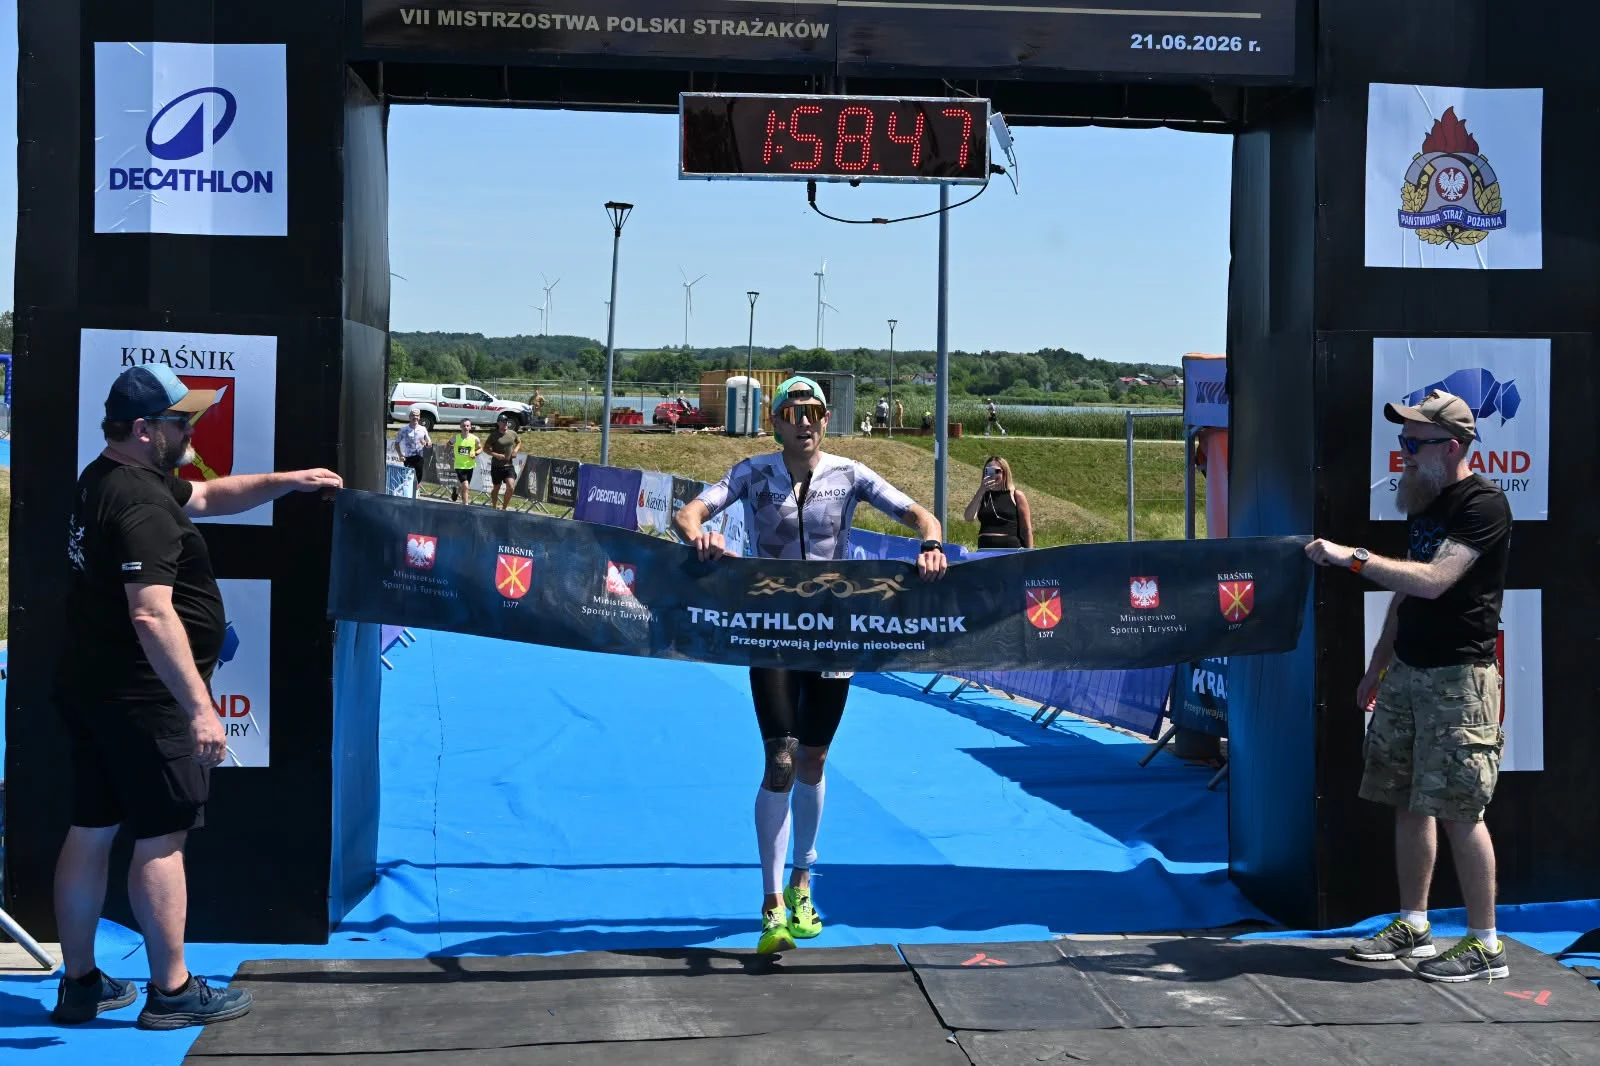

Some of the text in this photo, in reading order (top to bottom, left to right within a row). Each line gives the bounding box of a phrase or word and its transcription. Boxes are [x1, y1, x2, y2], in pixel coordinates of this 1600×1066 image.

[400, 9, 830, 39] VII MISTRZOSTWA POLSKI STRAŻAKÓW
[1130, 33, 1261, 52] 21.06.2026 r.
[109, 167, 273, 193] DECATHLON
[1400, 213, 1441, 226] PAŃSTWOWA
[1443, 209, 1463, 221] STRAŻ
[121, 345, 235, 371] KRAŚNIK
[498, 545, 534, 557] KRAŚNIK
[393, 569, 449, 585] Ministerstwo
[1217, 571, 1254, 581] KRAŚNIK
[593, 595, 649, 610] Ministerstwo
[581, 605, 610, 617] Sportu
[620, 610, 658, 623] Turystyki
[1120, 614, 1176, 622] Ministerstwo
[1110, 626, 1139, 636] Sportu
[1147, 624, 1187, 635] Turystyki
[730, 635, 925, 651] Przegrywają jedynie nieobecni
